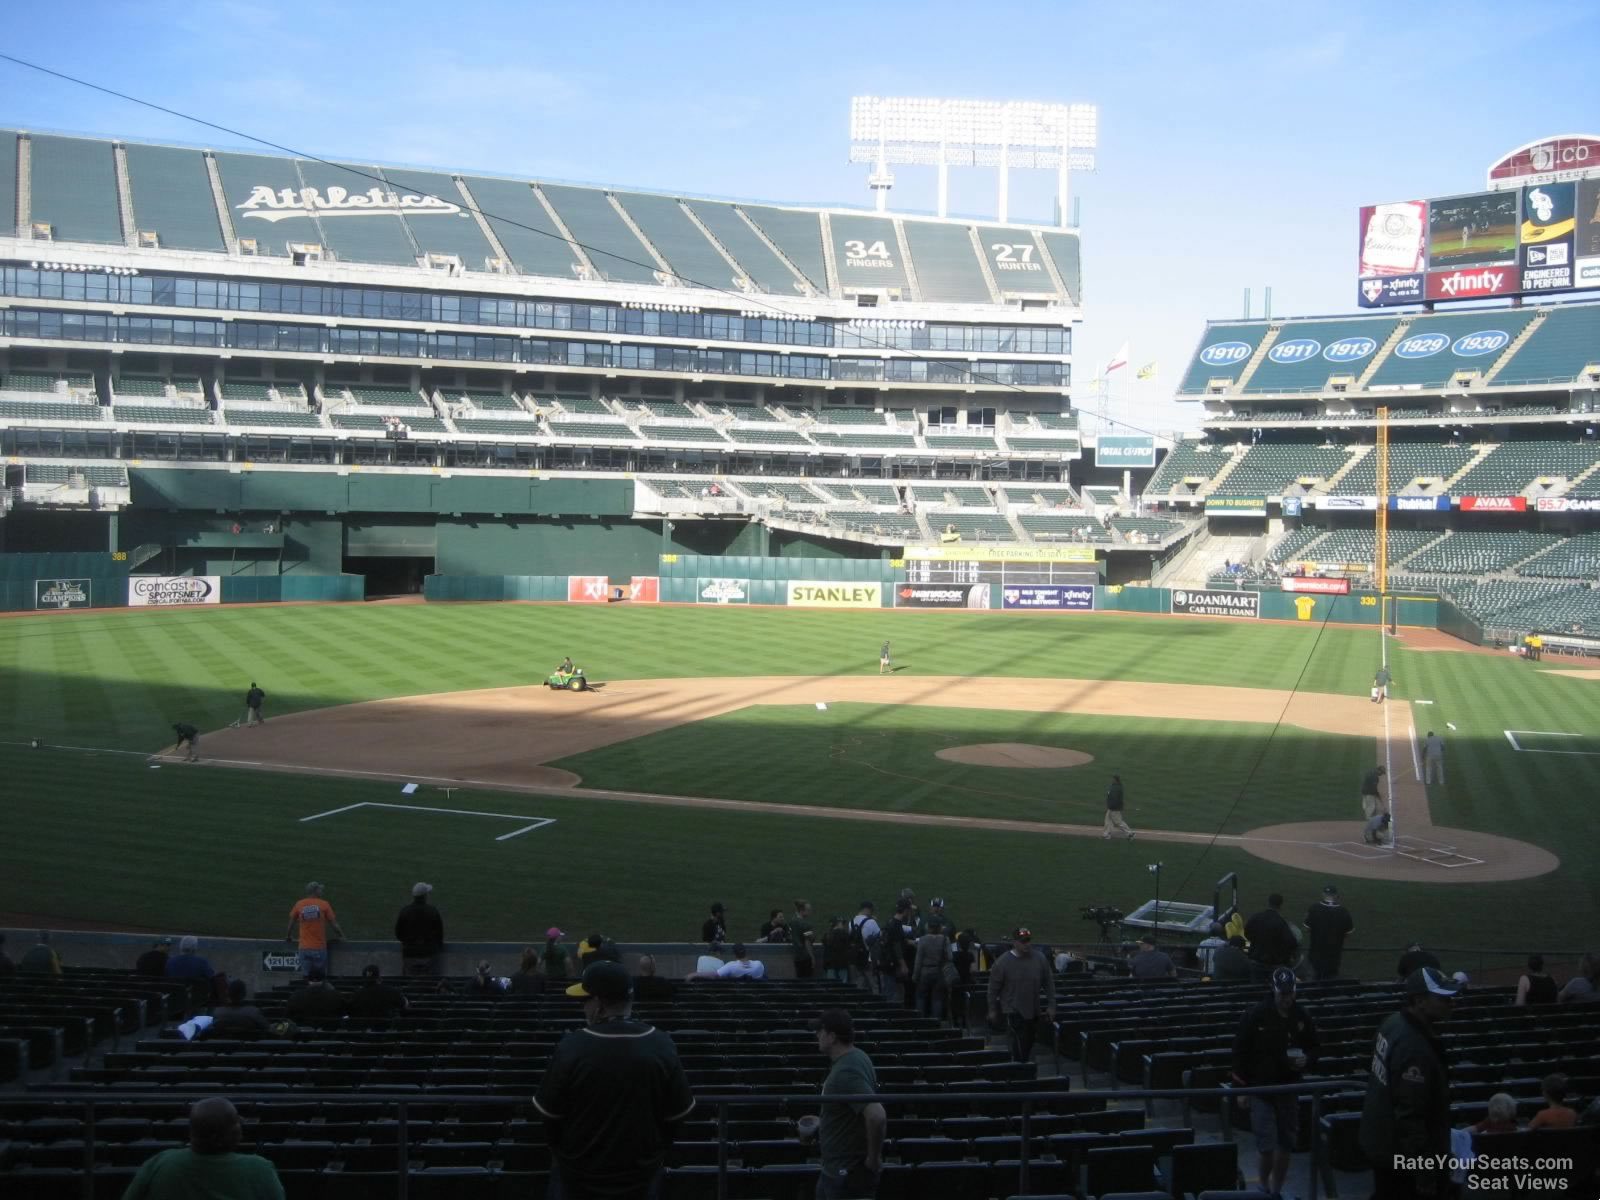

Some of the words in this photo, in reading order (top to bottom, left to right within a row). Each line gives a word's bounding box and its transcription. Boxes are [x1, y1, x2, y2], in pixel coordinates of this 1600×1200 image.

[235, 186, 461, 218] Athletics
[844, 240, 892, 259] 34
[991, 243, 1034, 262] 27
[846, 258, 894, 268] FINGERS
[997, 262, 1041, 271] HUNTER
[1524, 267, 1570, 280] ENGINEERED
[1389, 277, 1420, 291] xfinity
[1440, 271, 1503, 295] xfinity
[1522, 279, 1532, 290] TO
[1329, 340, 1372, 356] 1913
[1402, 338, 1443, 352] 1929
[1460, 336, 1503, 350] 1930
[1206, 346, 1247, 359] 1910
[1275, 344, 1314, 357] 1911
[1235, 499, 1264, 507] BUSINESS
[1474, 498, 1511, 508] AVAYA
[1538, 499, 1564, 510] 95.7
[138, 580, 188, 593] comcast
[41, 594, 86, 602] CHAMPIONS
[148, 590, 203, 600] SPORTSNET
[793, 586, 875, 602] STANLEY
[1064, 590, 1092, 600] xfinity
[1360, 596, 1376, 606] 330
[1189, 606, 1205, 614] CAR
[1207, 607, 1227, 615] TITLE
[1229, 608, 1255, 617] LOANS
[269, 957, 283, 966] 121
